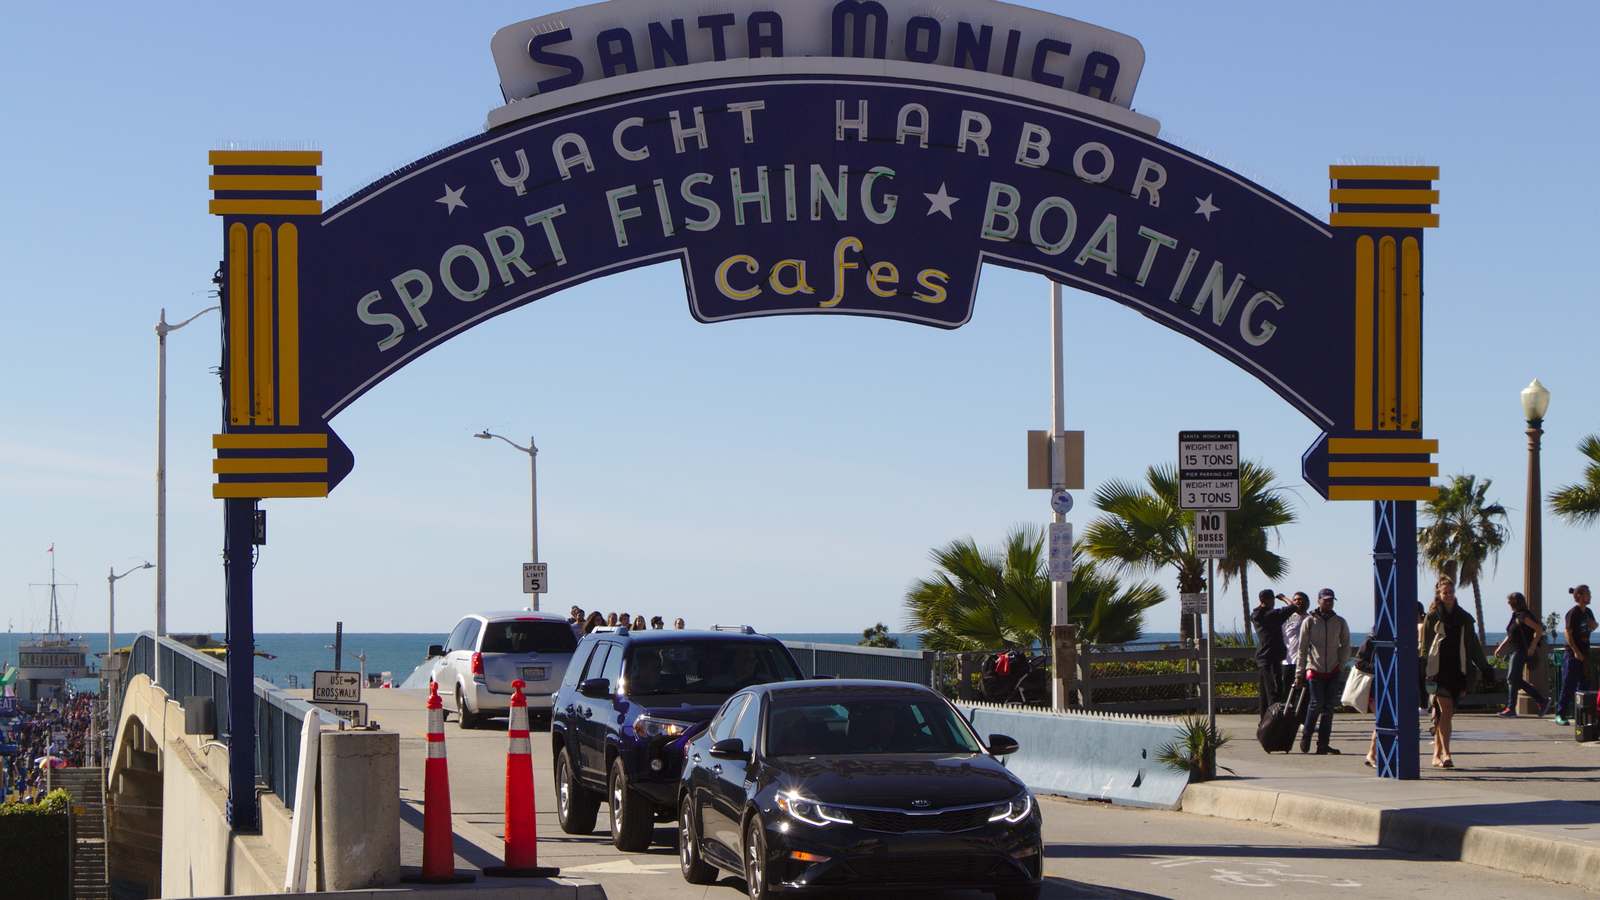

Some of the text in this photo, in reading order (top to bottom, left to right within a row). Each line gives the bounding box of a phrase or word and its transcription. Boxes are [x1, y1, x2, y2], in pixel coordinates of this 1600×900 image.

[528, 0, 1120, 103] SANTA MONICA
[491, 99, 1168, 207] YACHT HARBOR
[356, 164, 1285, 352] SPORT FISHING BOATING
[714, 236, 951, 308] cafes
[1185, 443, 1233, 451] WEIGHT LIMIT
[1185, 454, 1234, 466] 15 TONS
[1188, 493, 1232, 503] 3 TONS
[1201, 514, 1220, 531] NO
[1198, 533, 1224, 542] BUSES
[531, 579, 540, 590] 5
[330, 675, 344, 685] USE
[316, 687, 358, 698] CROSSWALK
